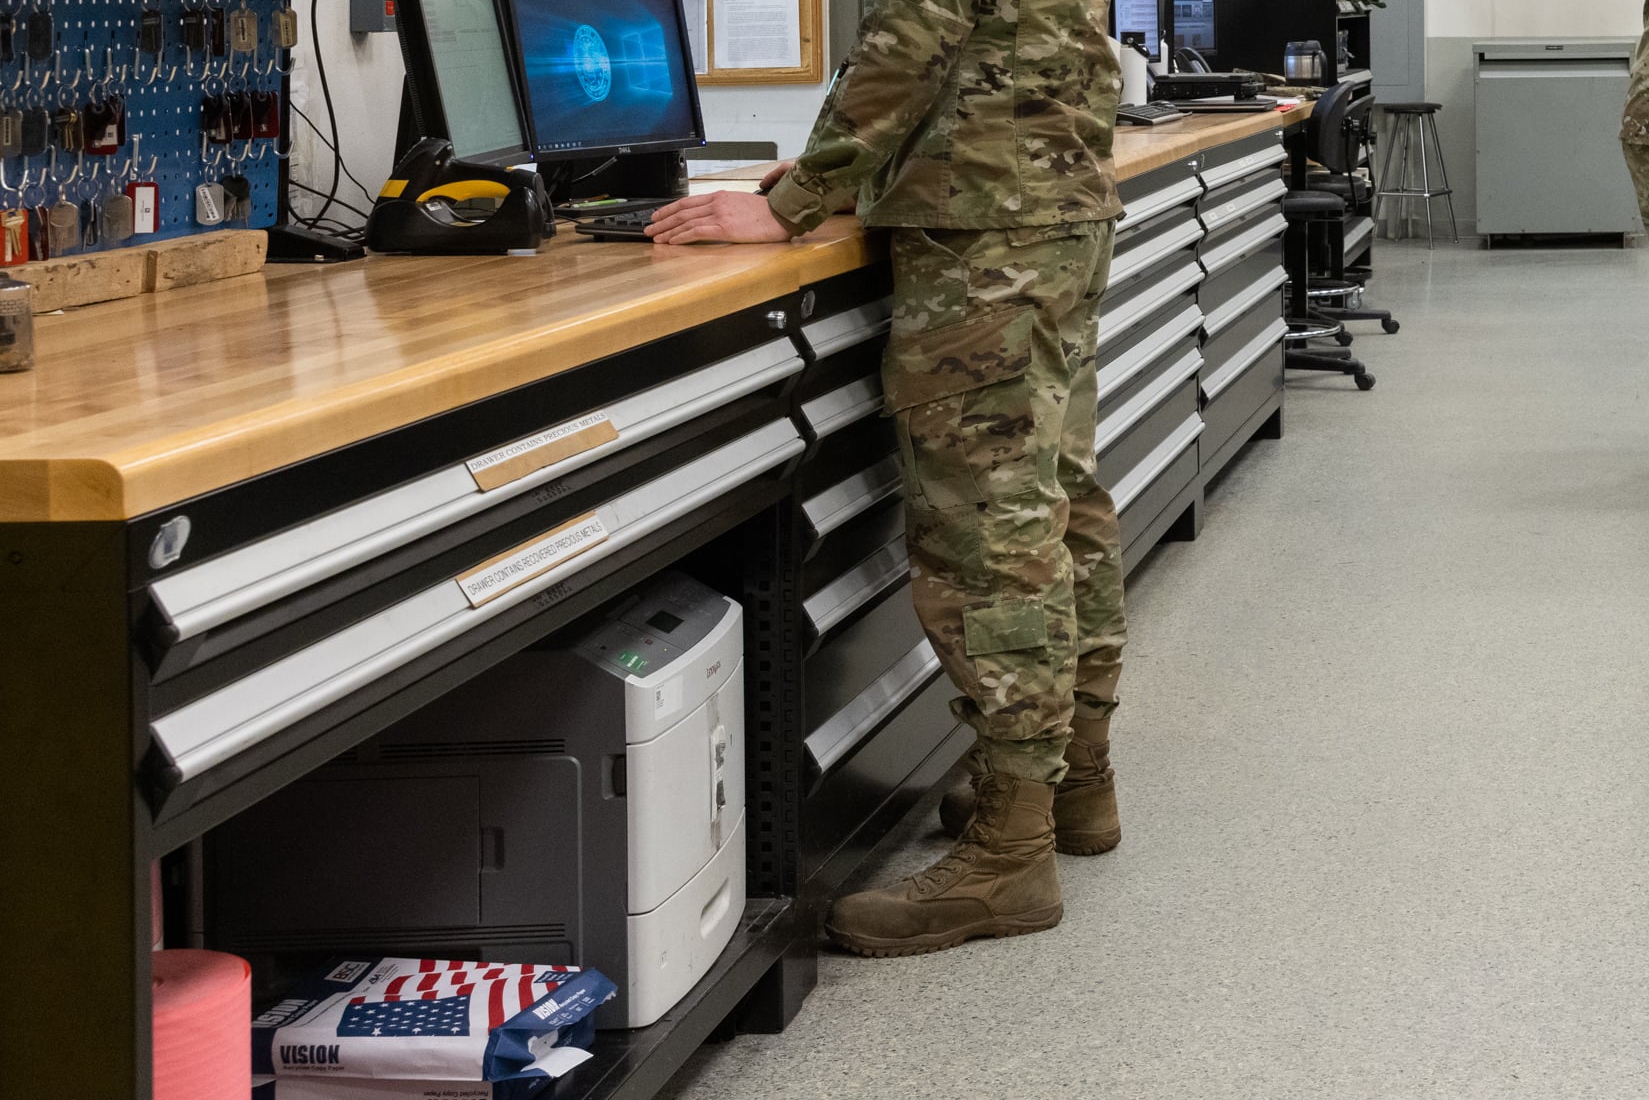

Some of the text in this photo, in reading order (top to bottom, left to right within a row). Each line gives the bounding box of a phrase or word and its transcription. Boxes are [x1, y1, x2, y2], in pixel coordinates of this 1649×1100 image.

[470, 412, 606, 471] DRAWER CONTAINS PRECIOUS METALS
[466, 521, 604, 596] DRAWER CONTAINS RECOVERED PRECIOUS METALS
[280, 1044, 340, 1065] VISION
